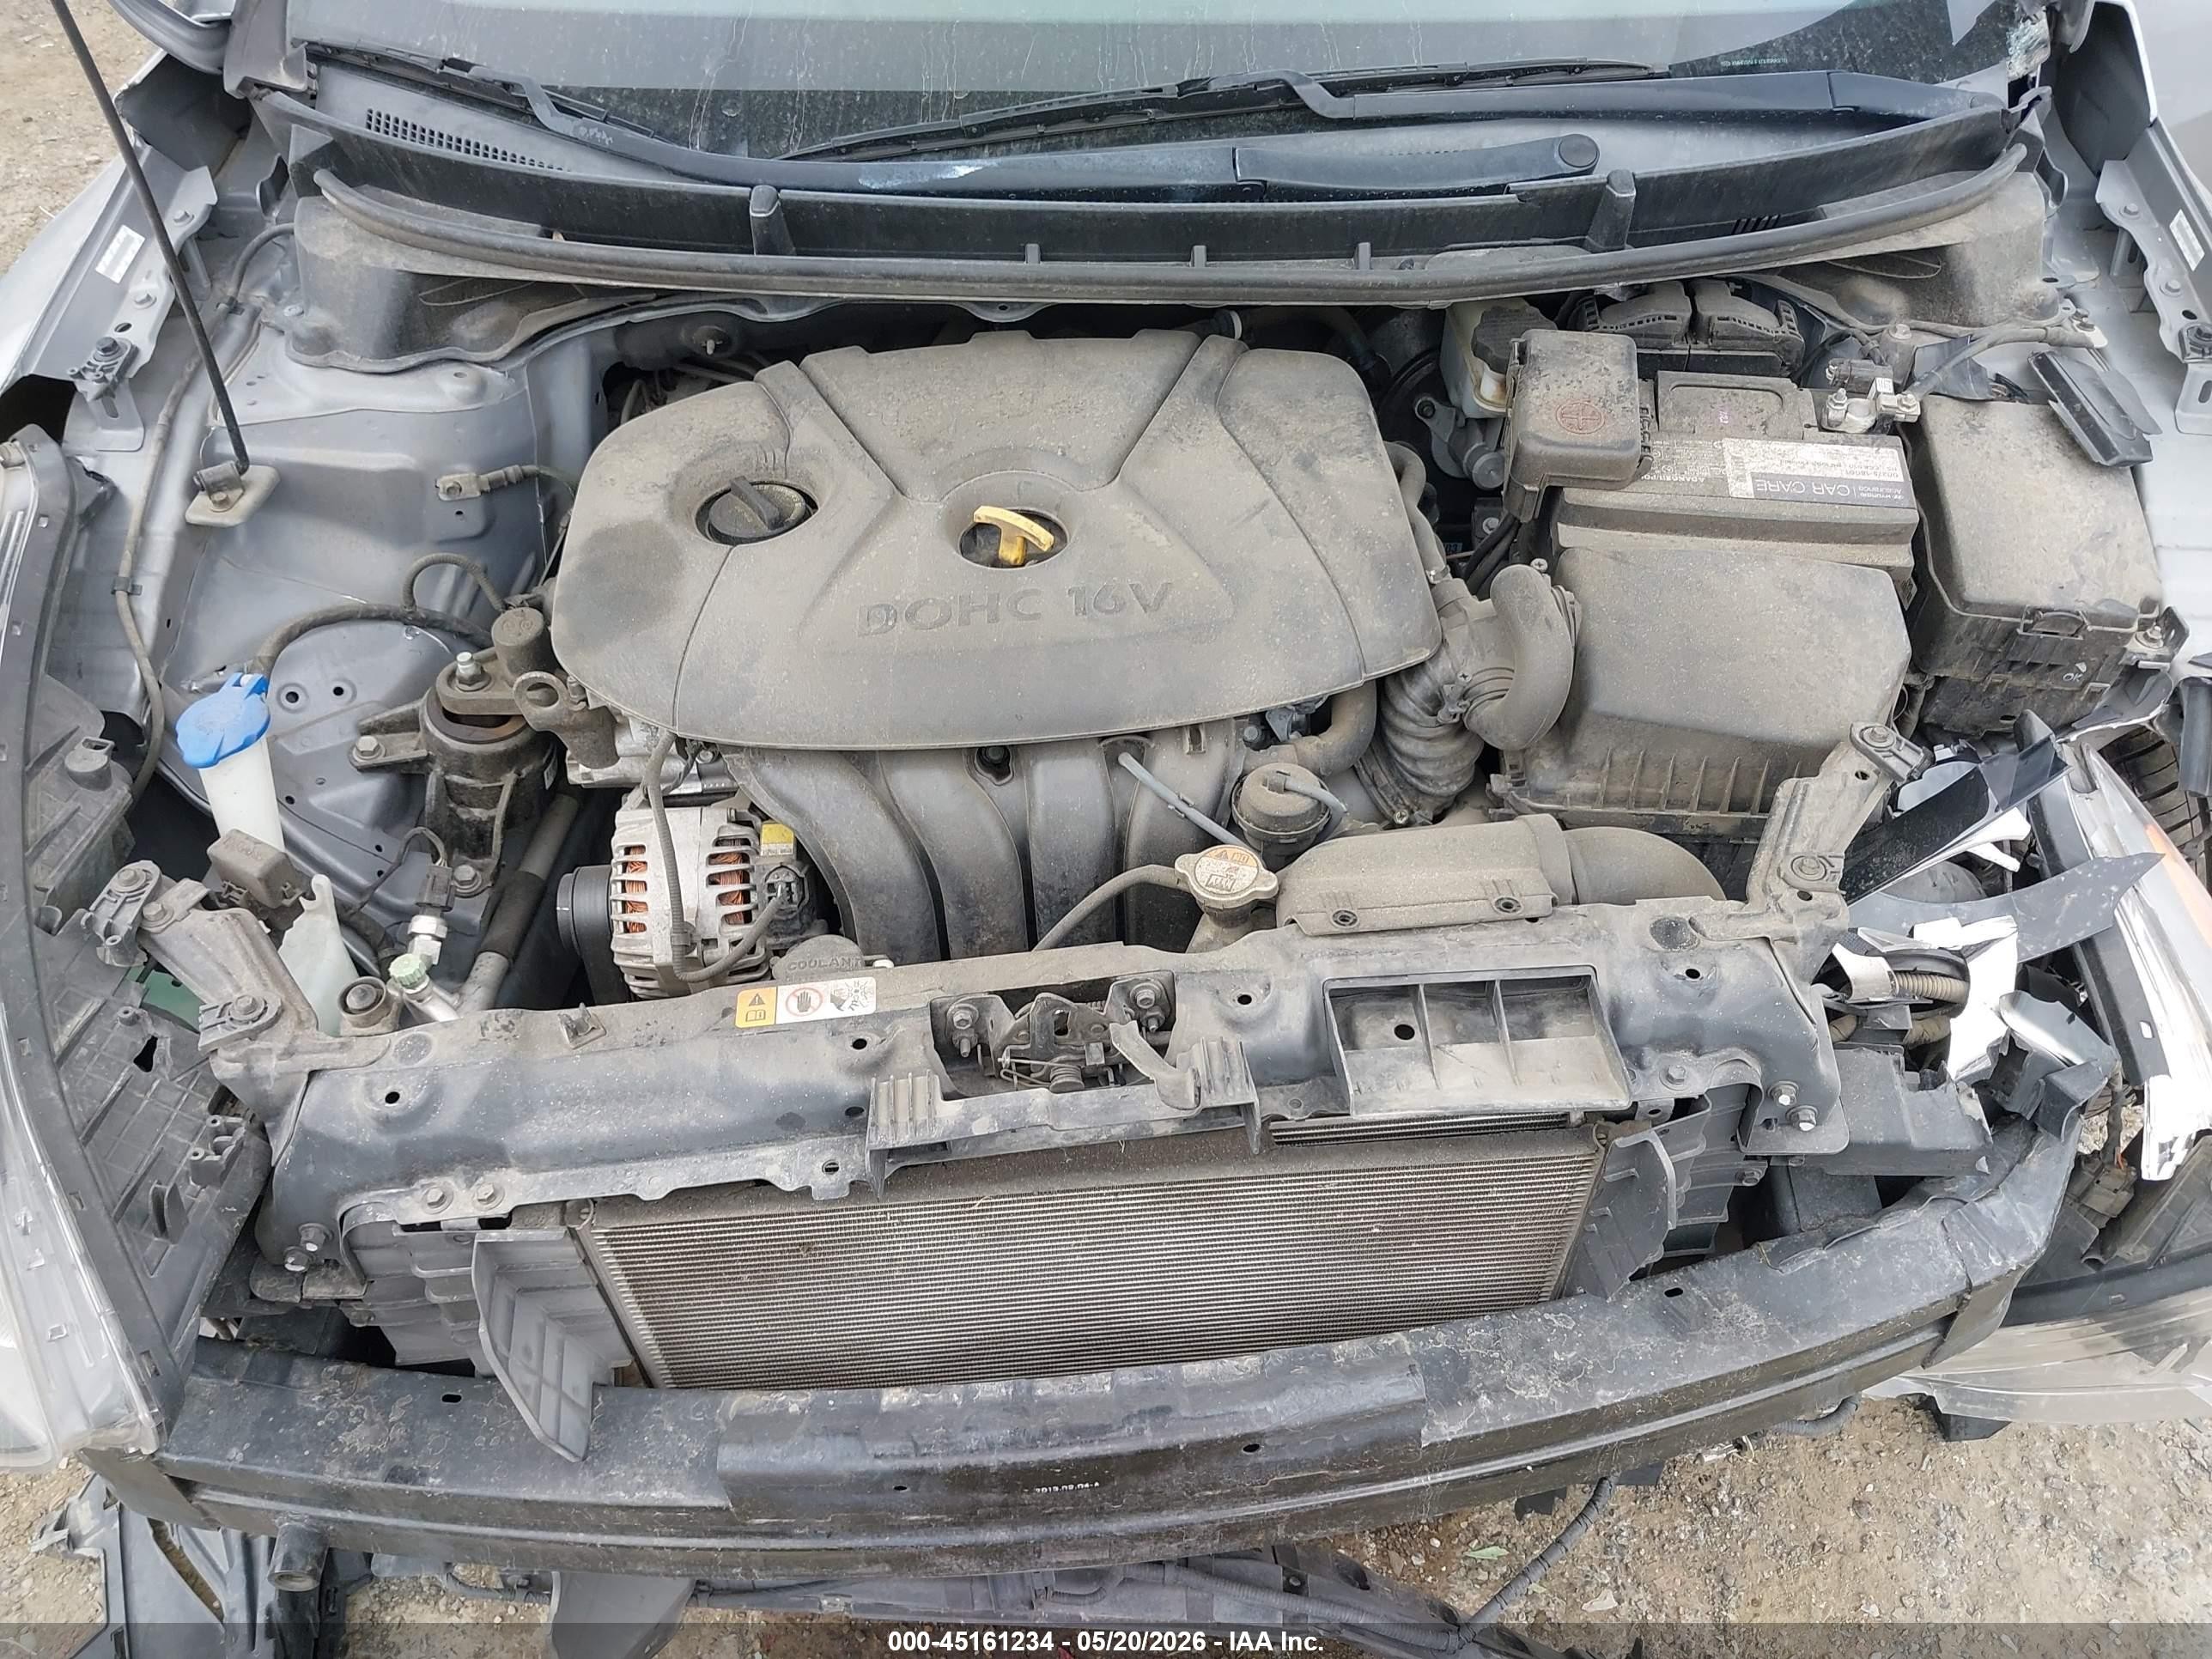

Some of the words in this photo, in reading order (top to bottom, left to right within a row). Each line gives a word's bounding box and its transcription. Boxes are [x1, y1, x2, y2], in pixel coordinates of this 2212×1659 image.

[1754, 479, 1806, 495] CARE
[1811, 482, 1850, 496] CAR
[856, 587, 1044, 637] DOHC
[1067, 581, 1173, 617] 16V
[2063, 673, 2082, 682] OK
[787, 956, 862, 971] COOLANT
